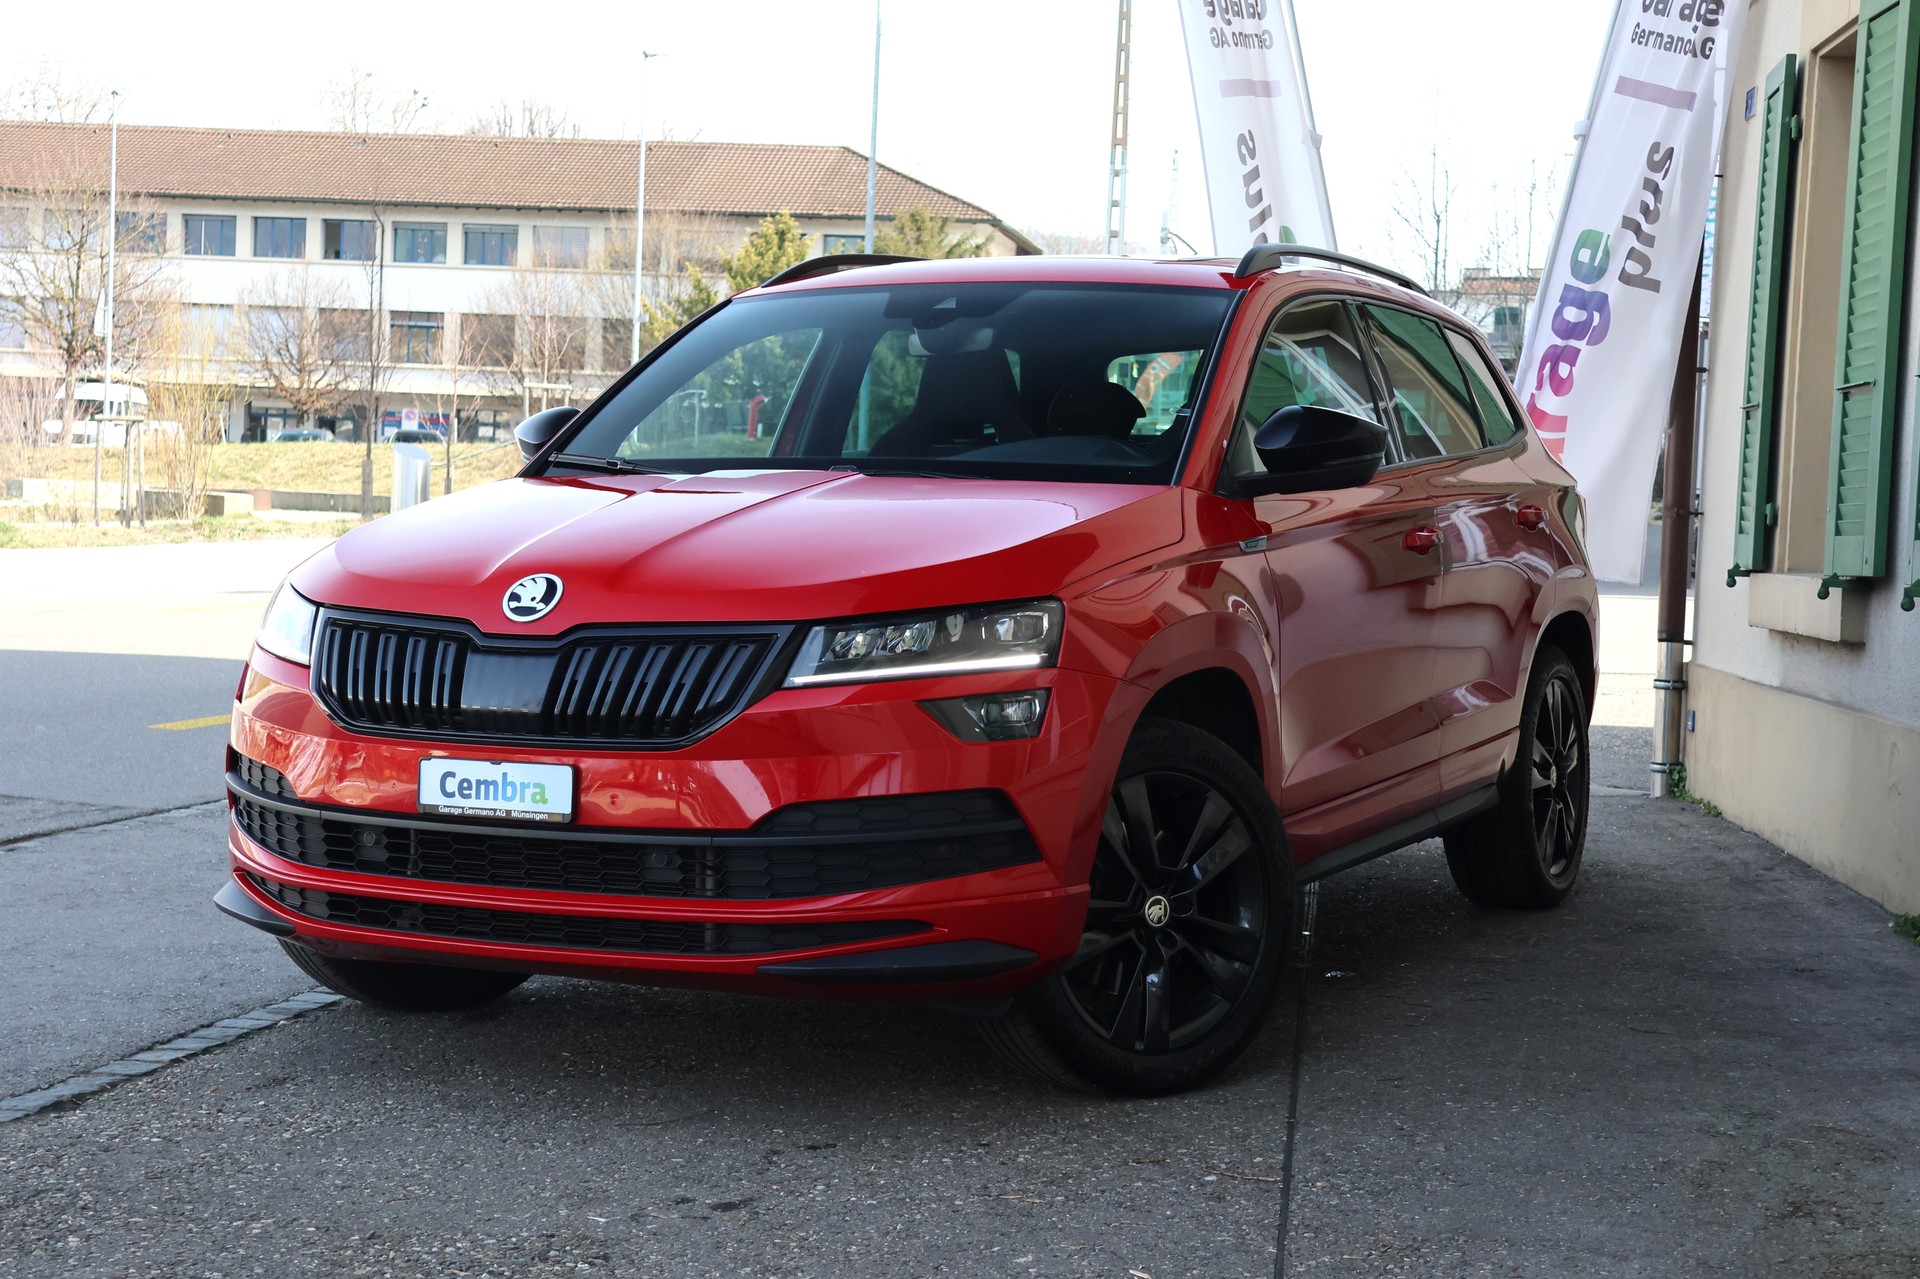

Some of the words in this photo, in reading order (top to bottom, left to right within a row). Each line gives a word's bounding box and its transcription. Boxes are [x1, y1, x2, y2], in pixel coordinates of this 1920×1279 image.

[1631, 22, 1693, 56] Germano
[1618, 141, 1674, 293] plus
[440, 771, 548, 805] Cembra
[439, 805, 463, 815] Garage
[464, 806, 495, 816] Germano
[495, 808, 506, 817] AG
[512, 809, 549, 820] Münsingen
